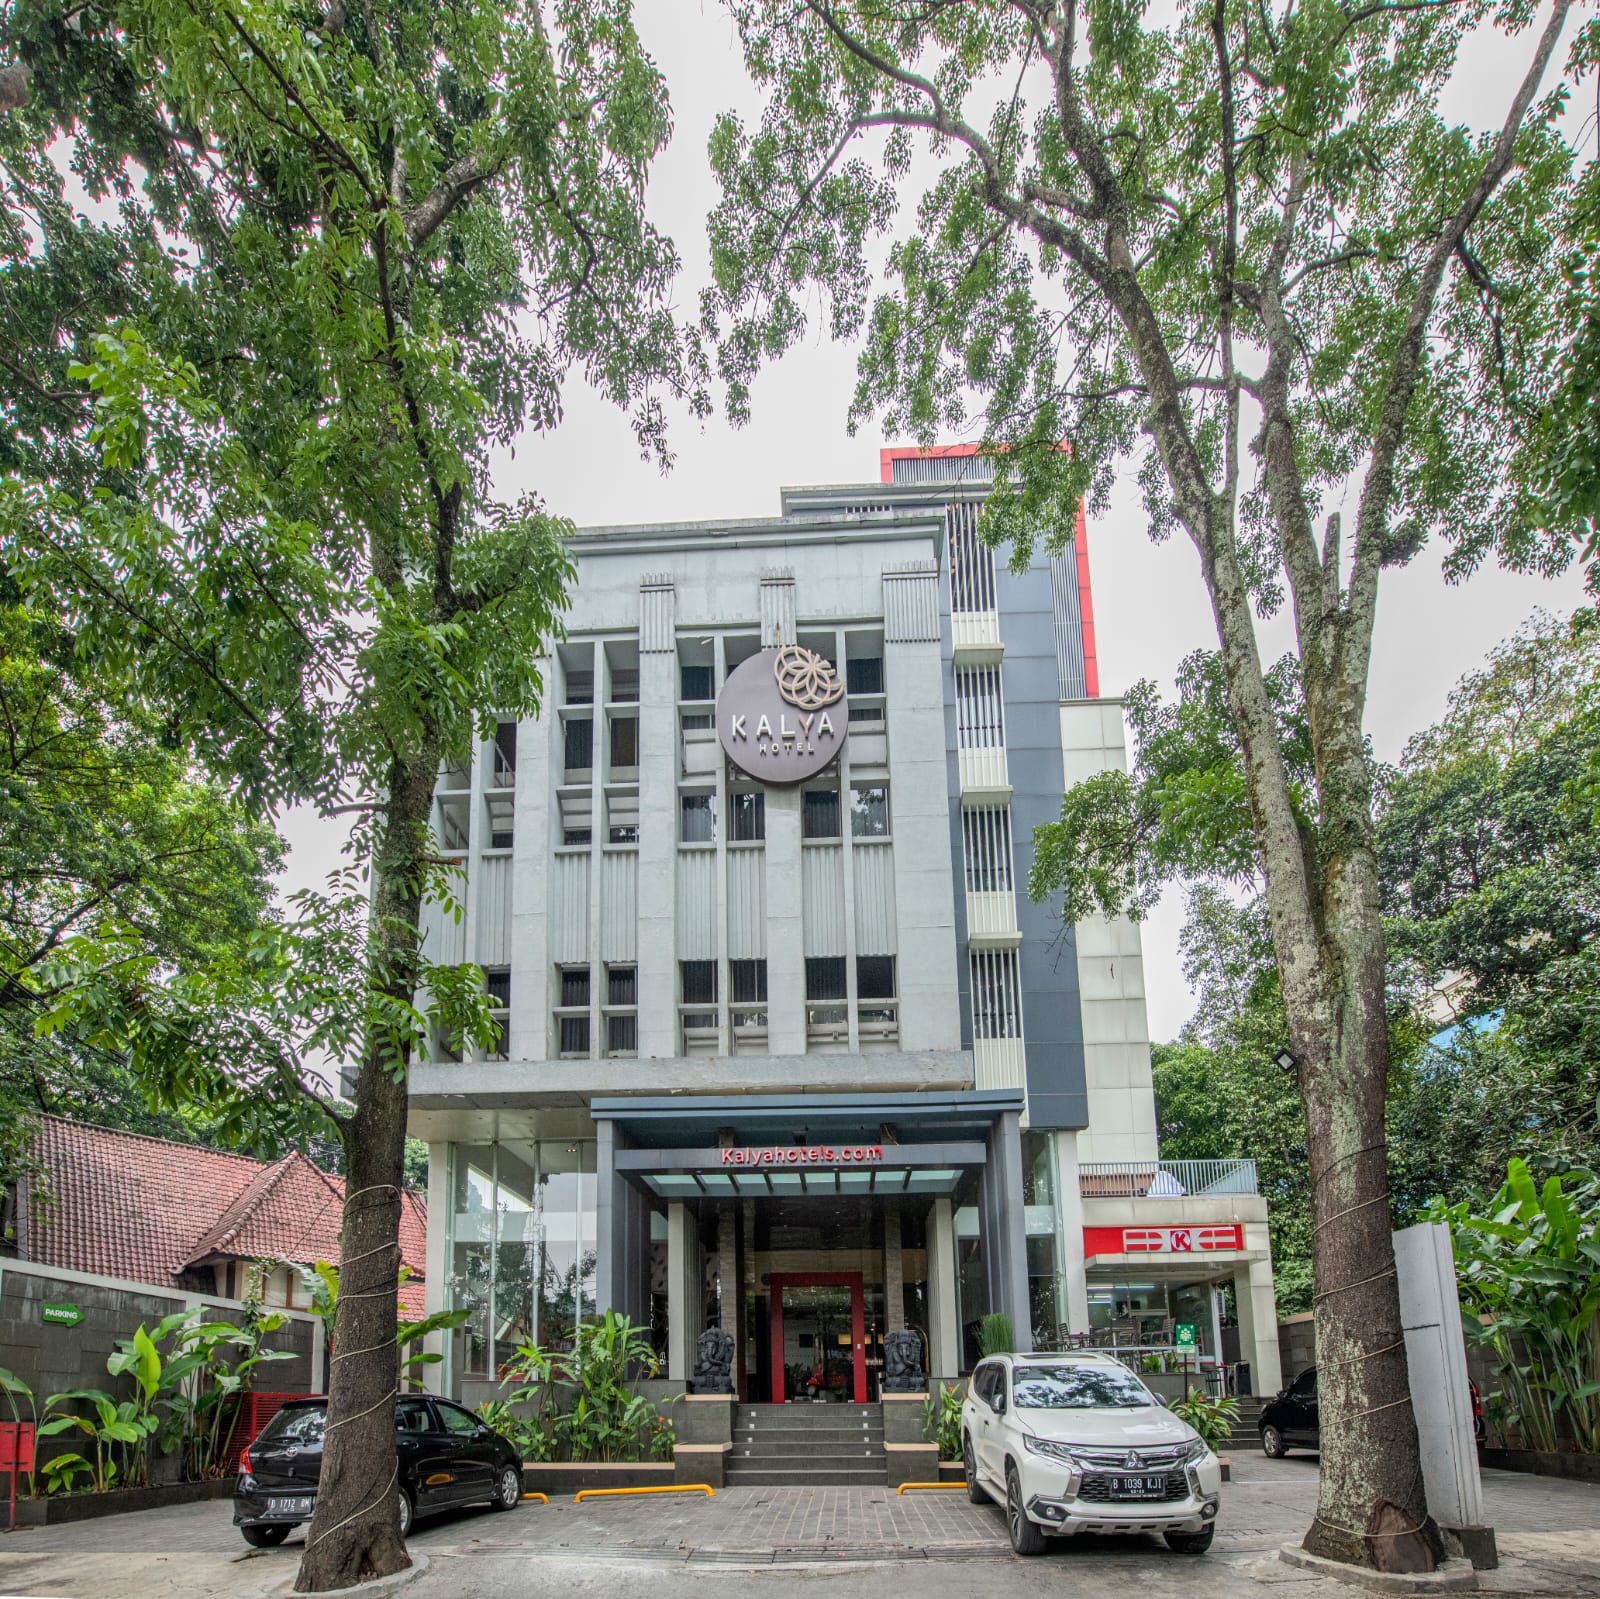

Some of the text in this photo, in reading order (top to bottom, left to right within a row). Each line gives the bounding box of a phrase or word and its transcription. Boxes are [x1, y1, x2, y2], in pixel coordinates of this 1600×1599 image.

[732, 712, 834, 741] KALYA
[759, 742, 815, 755] HOTEL
[721, 1145, 883, 1166] Kalyahotels.com
[1172, 1231, 1191, 1251] K
[45, 1308, 78, 1319] PARKING
[1113, 1479, 1118, 1489] B
[1123, 1479, 1142, 1489] 1039
[280, 1499, 296, 1508] 1712
